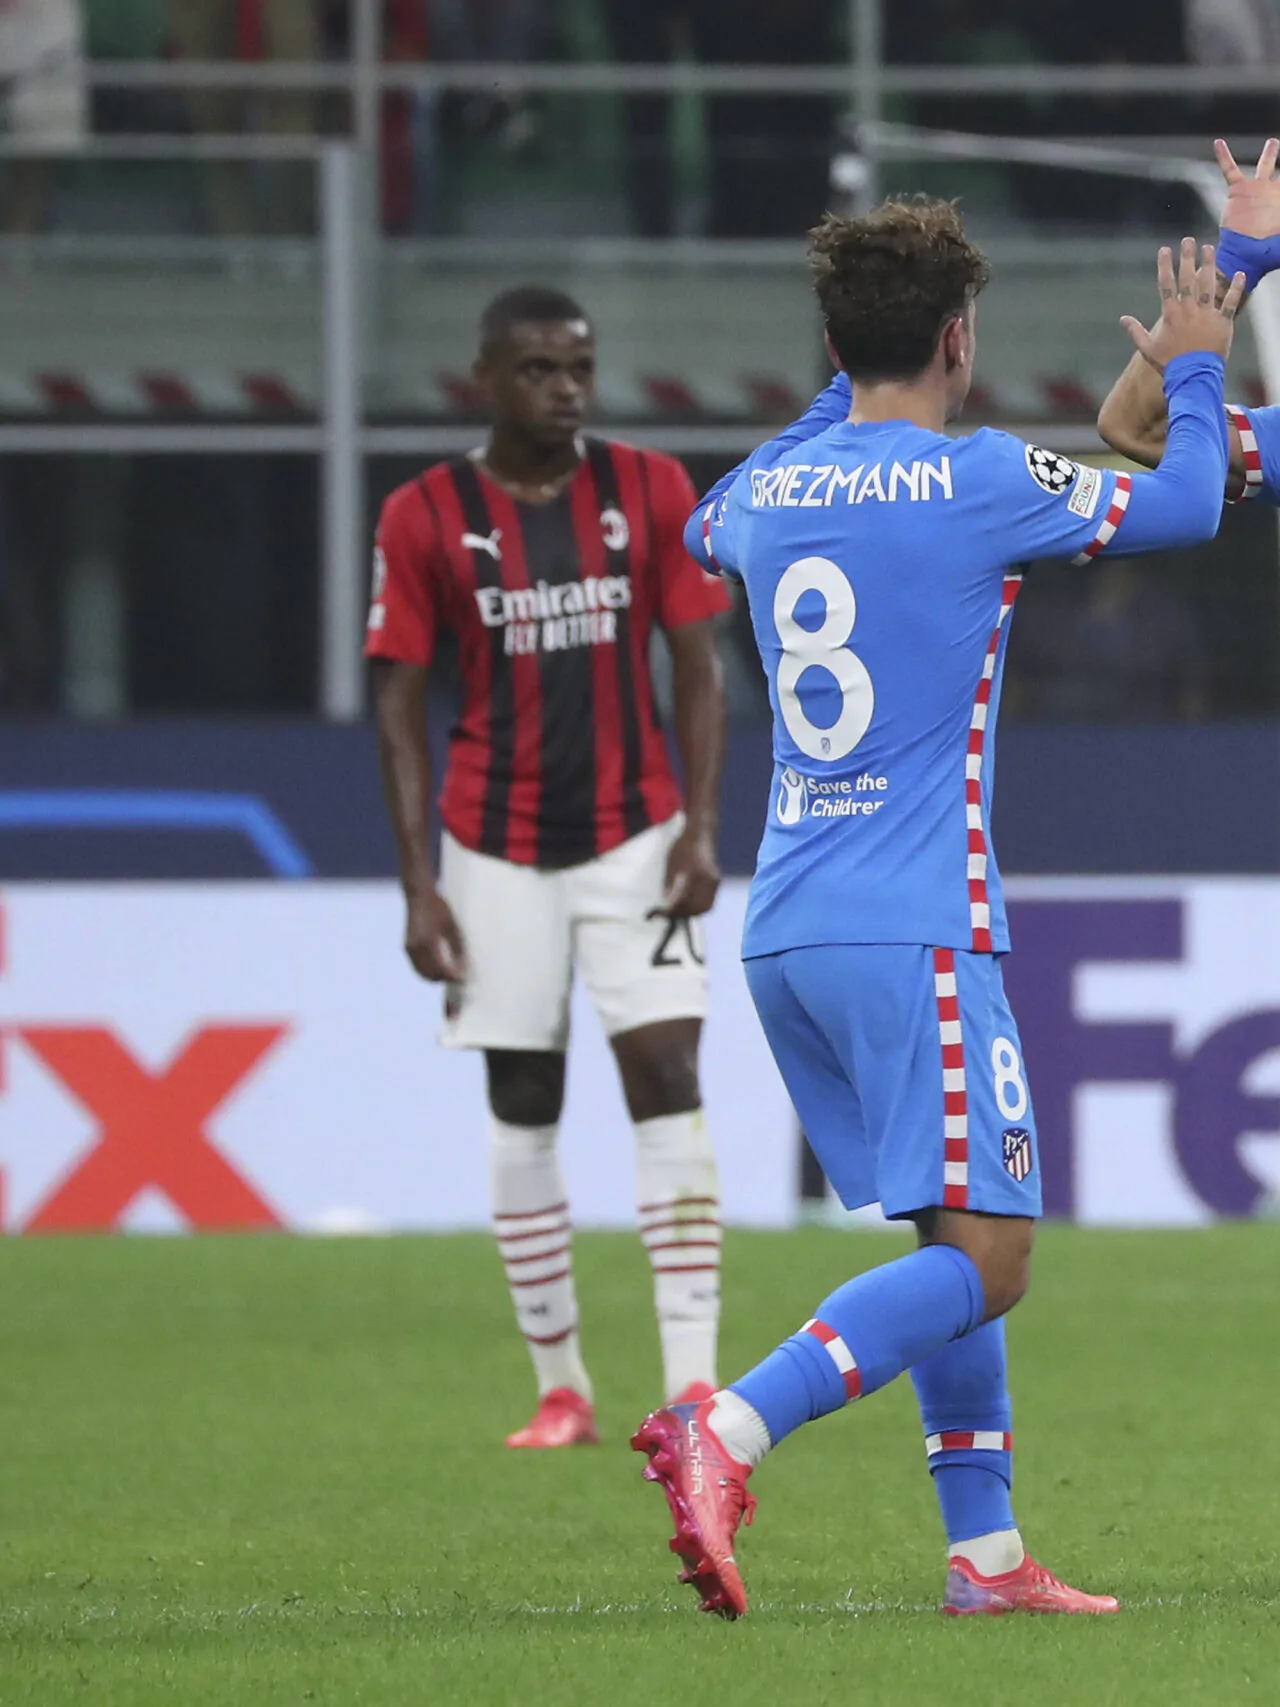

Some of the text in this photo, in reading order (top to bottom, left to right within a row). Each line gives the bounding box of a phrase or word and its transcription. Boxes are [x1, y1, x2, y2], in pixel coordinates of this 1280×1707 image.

[751, 456, 953, 507] GRIEZMANN
[475, 575, 632, 627] Emirates
[774, 556, 875, 762] 8
[807, 773, 888, 795] Save the
[991, 1037, 1027, 1121] 8
[688, 1420, 703, 1495] ULTRA
